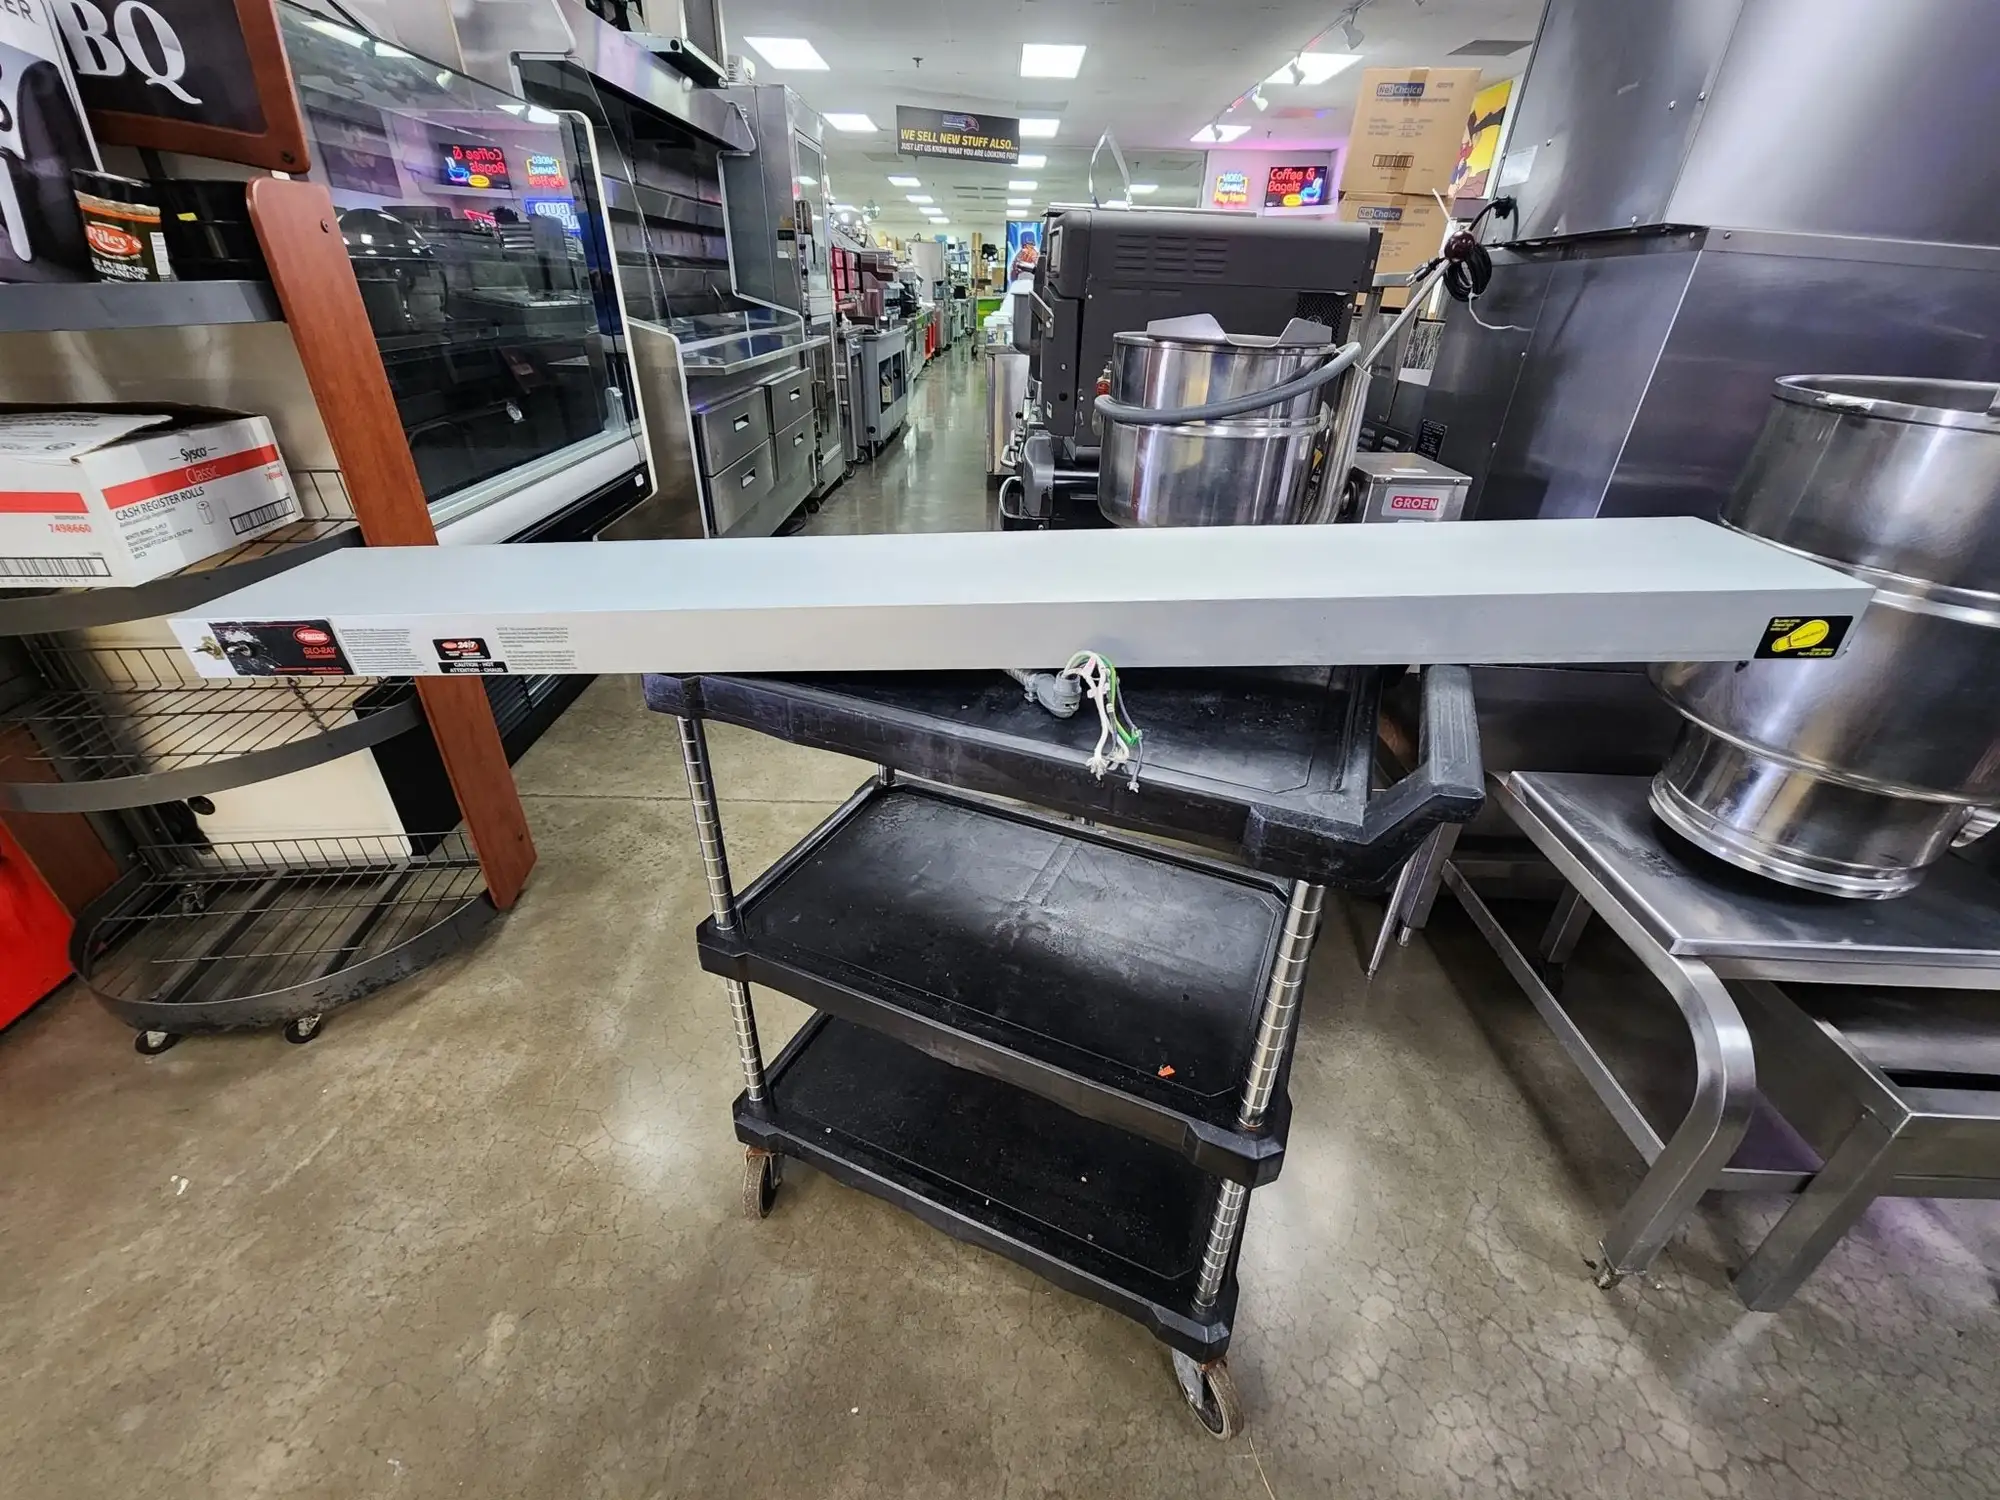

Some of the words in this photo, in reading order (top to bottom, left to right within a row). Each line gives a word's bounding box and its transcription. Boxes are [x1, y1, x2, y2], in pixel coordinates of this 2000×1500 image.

[0, 0, 37, 24] ER
[901, 129, 916, 141] WE
[917, 131, 938, 143] SELL
[940, 133, 960, 145] NEW
[962, 135, 989, 148] STUFF
[989, 138, 1019, 150] ALSO...
[901, 142, 913, 150] JUST
[914, 143, 924, 151] LET
[924, 144, 932, 152] US
[948, 147, 963, 155] WHAT
[963, 148, 974, 156] YOU
[974, 149, 984, 157] ARE
[984, 150, 1006, 159] LOOKING
[1270, 168, 1303, 180] Coffee
[1306, 167, 1315, 180] &
[1268, 181, 1301, 194] Bagels
[1359, 207, 1401, 219] NetChoice
[180, 446, 208, 464] Sysco
[185, 464, 221, 484] Classic
[115, 506, 141, 521] CASH
[141, 493, 181, 514] REGISTER
[180, 486, 205, 502] ROLLS
[1393, 497, 1438, 509] GROEN
[303, 646, 336, 655] GLO-RAY
